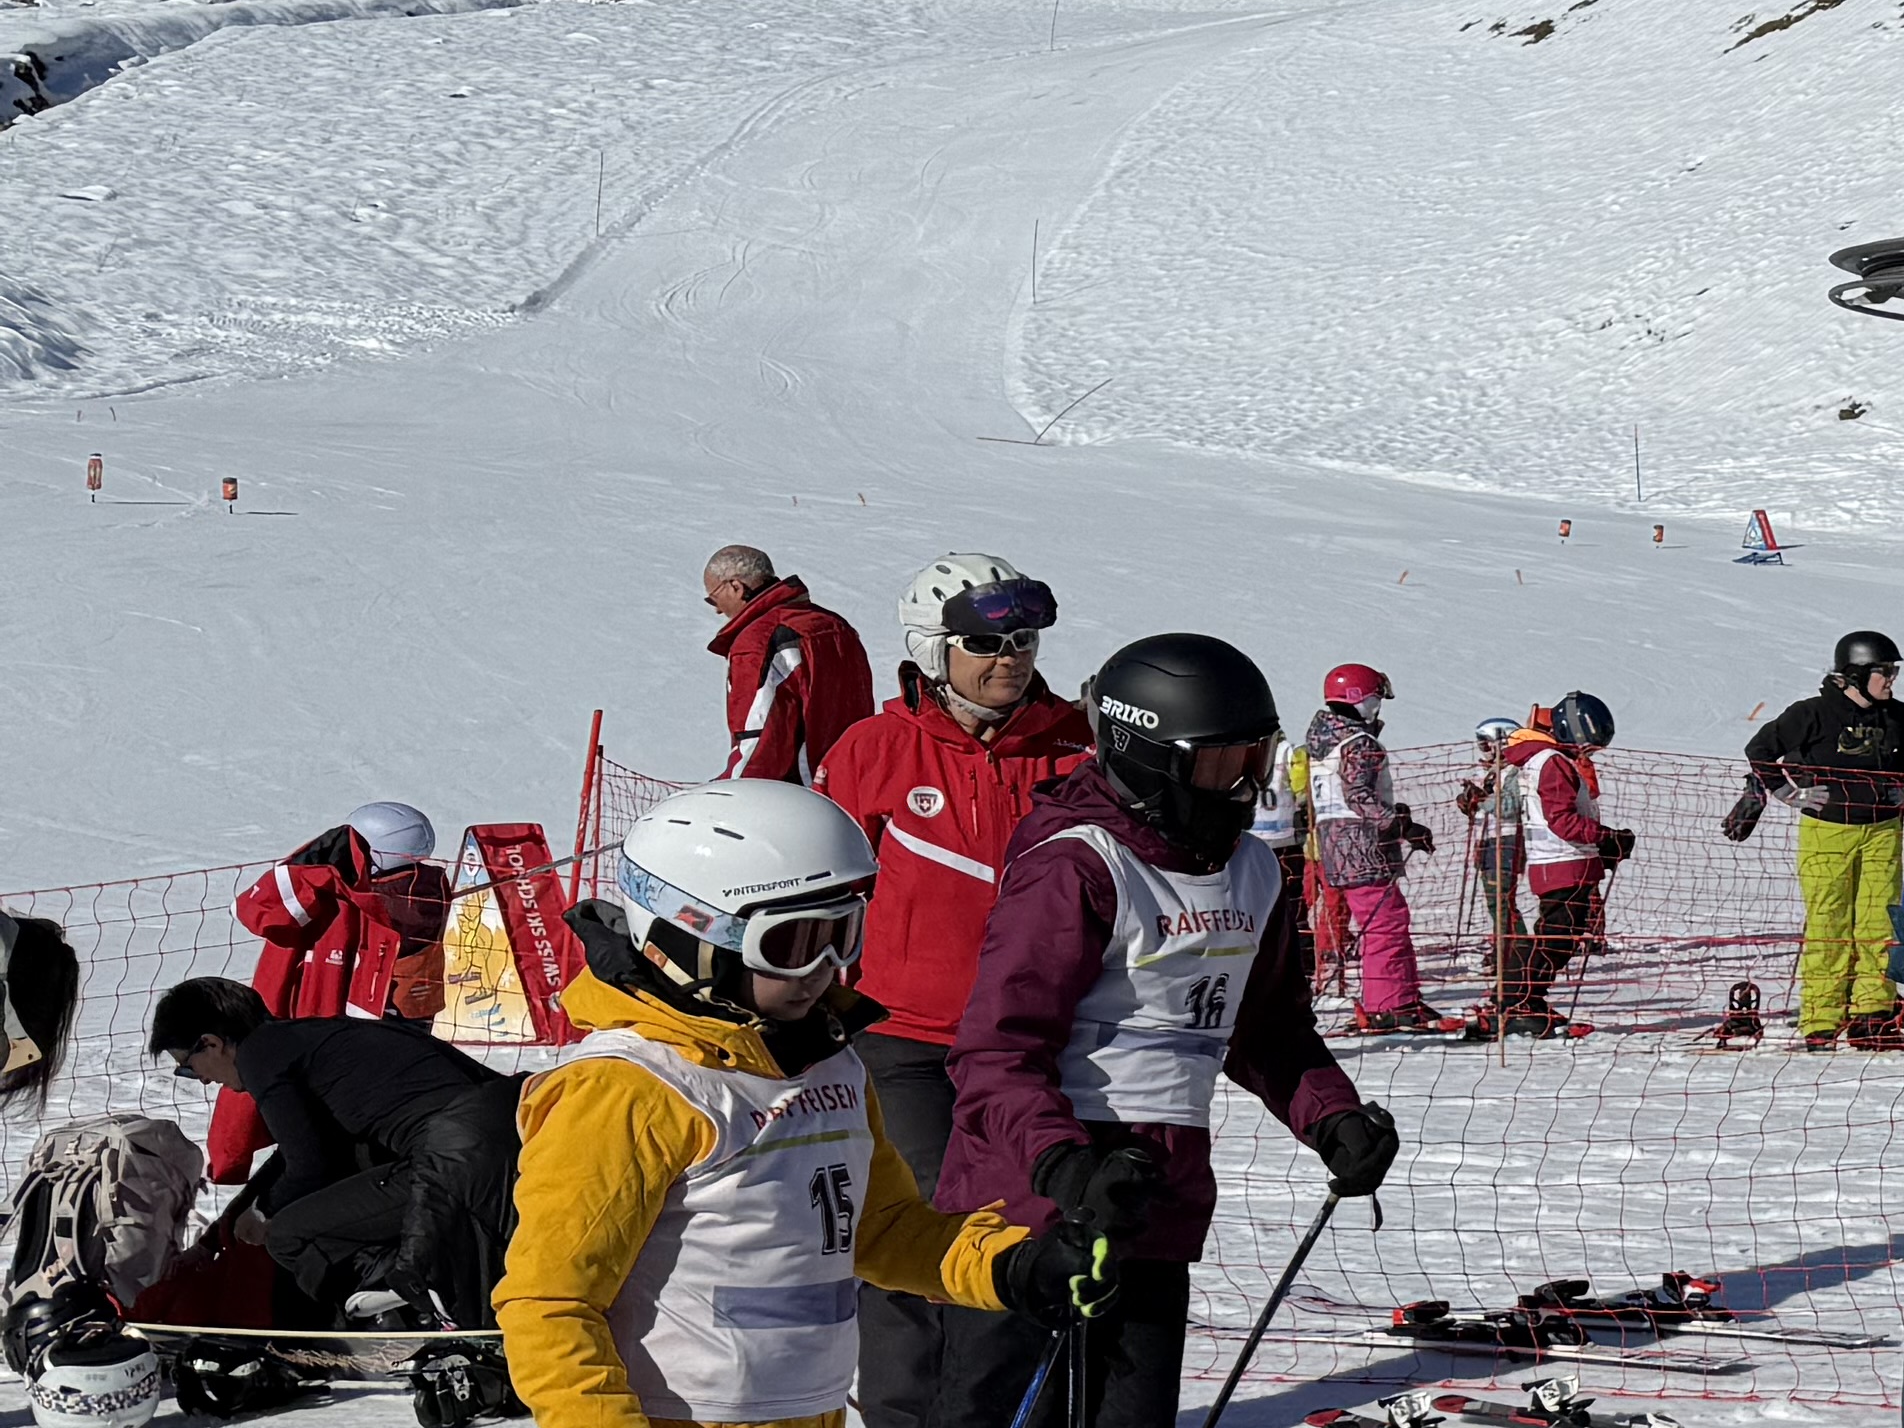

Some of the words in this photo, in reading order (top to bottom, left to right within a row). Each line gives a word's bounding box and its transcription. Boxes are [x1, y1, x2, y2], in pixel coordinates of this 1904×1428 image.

[733, 877, 802, 896] INTERSPORT
[526, 911, 546, 937] SKI
[534, 939, 562, 987] SWISS
[808, 1163, 854, 1255] 15
